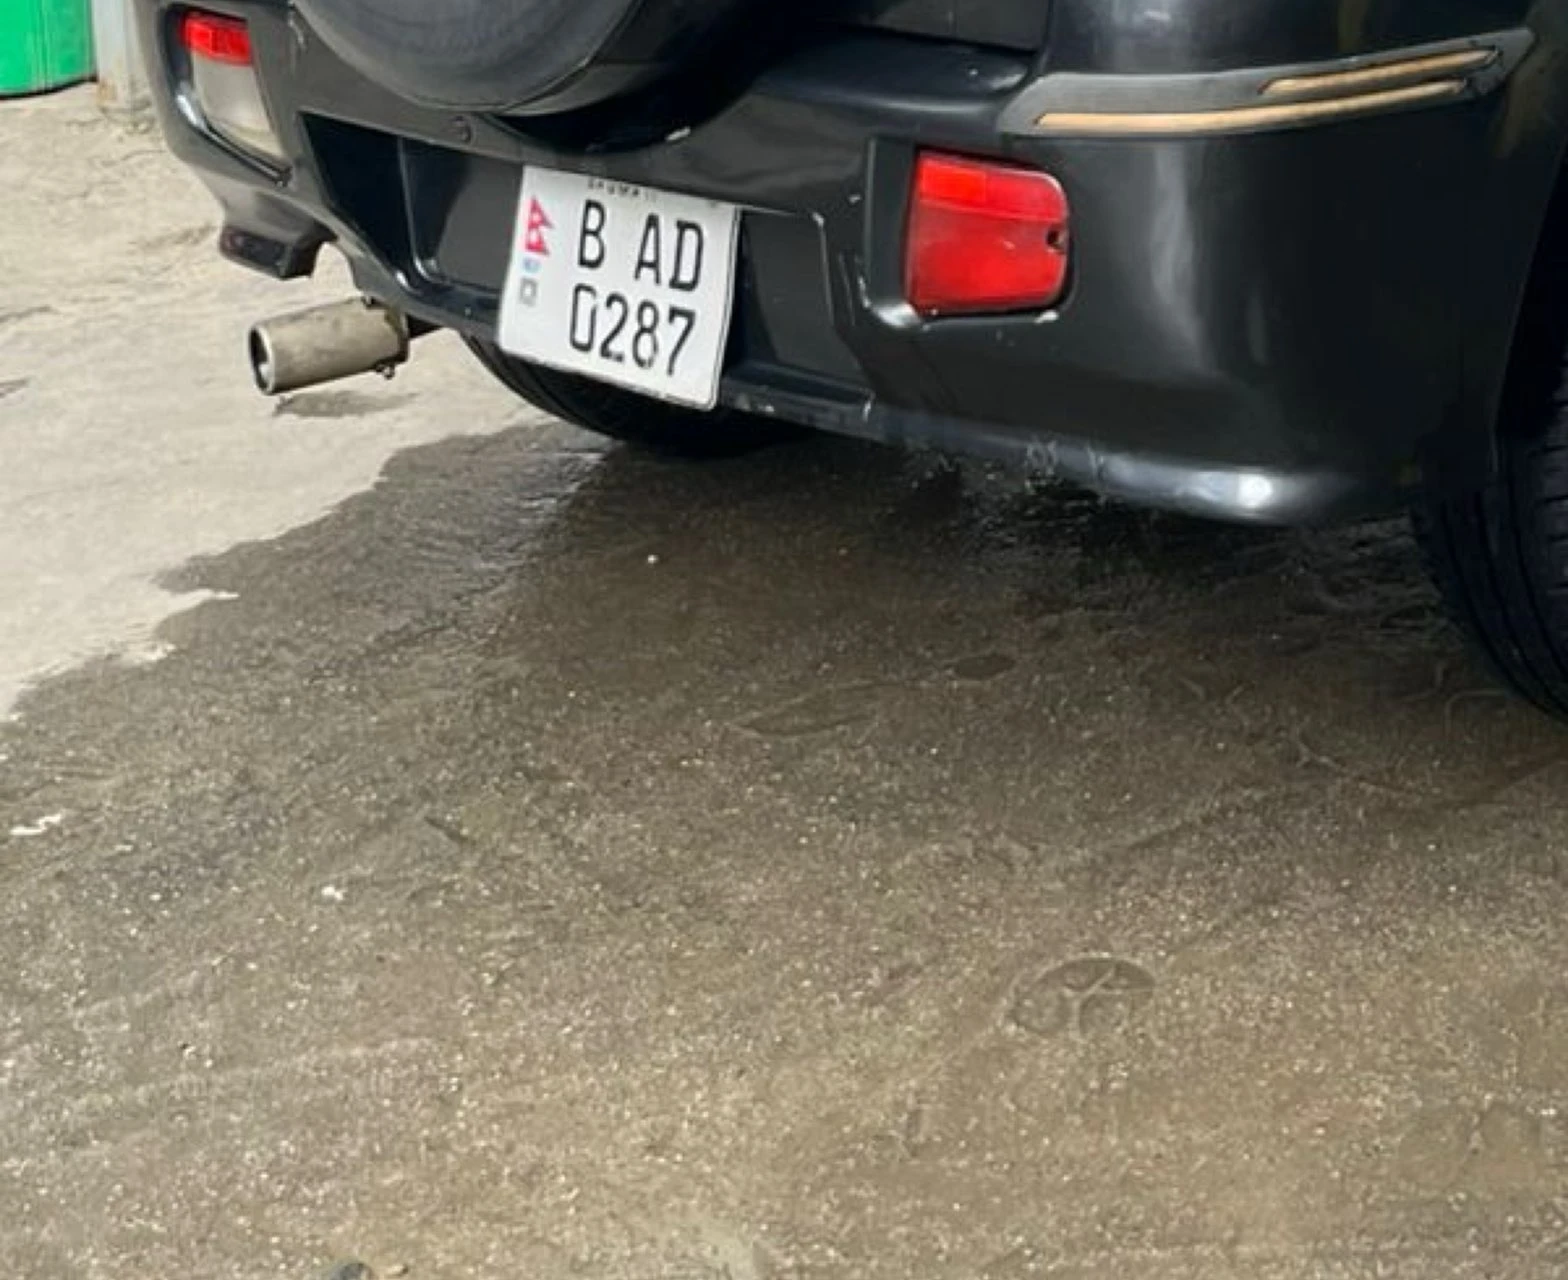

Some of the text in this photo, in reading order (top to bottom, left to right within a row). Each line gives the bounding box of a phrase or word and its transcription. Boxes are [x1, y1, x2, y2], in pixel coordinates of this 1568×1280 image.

[577, 198, 705, 292] B AD
[569, 282, 696, 377] 0287
